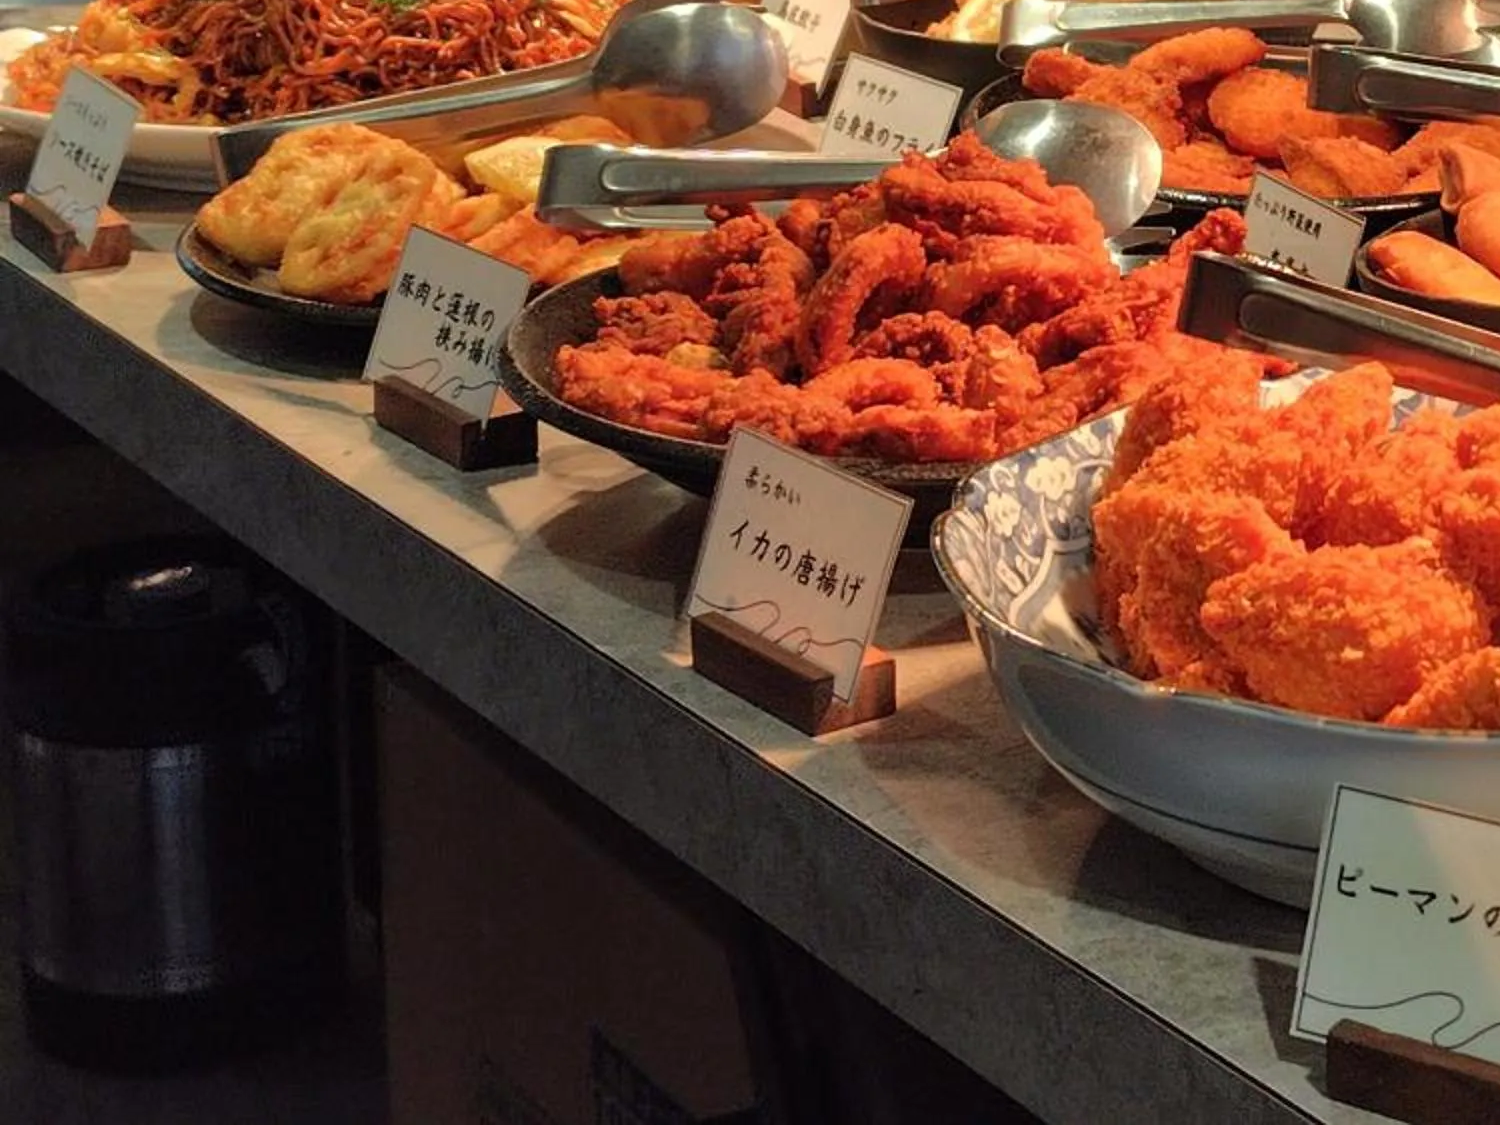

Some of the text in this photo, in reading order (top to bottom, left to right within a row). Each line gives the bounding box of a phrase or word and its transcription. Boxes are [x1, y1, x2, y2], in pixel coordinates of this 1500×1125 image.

[728, 518, 867, 609] イカの唐揚げ
